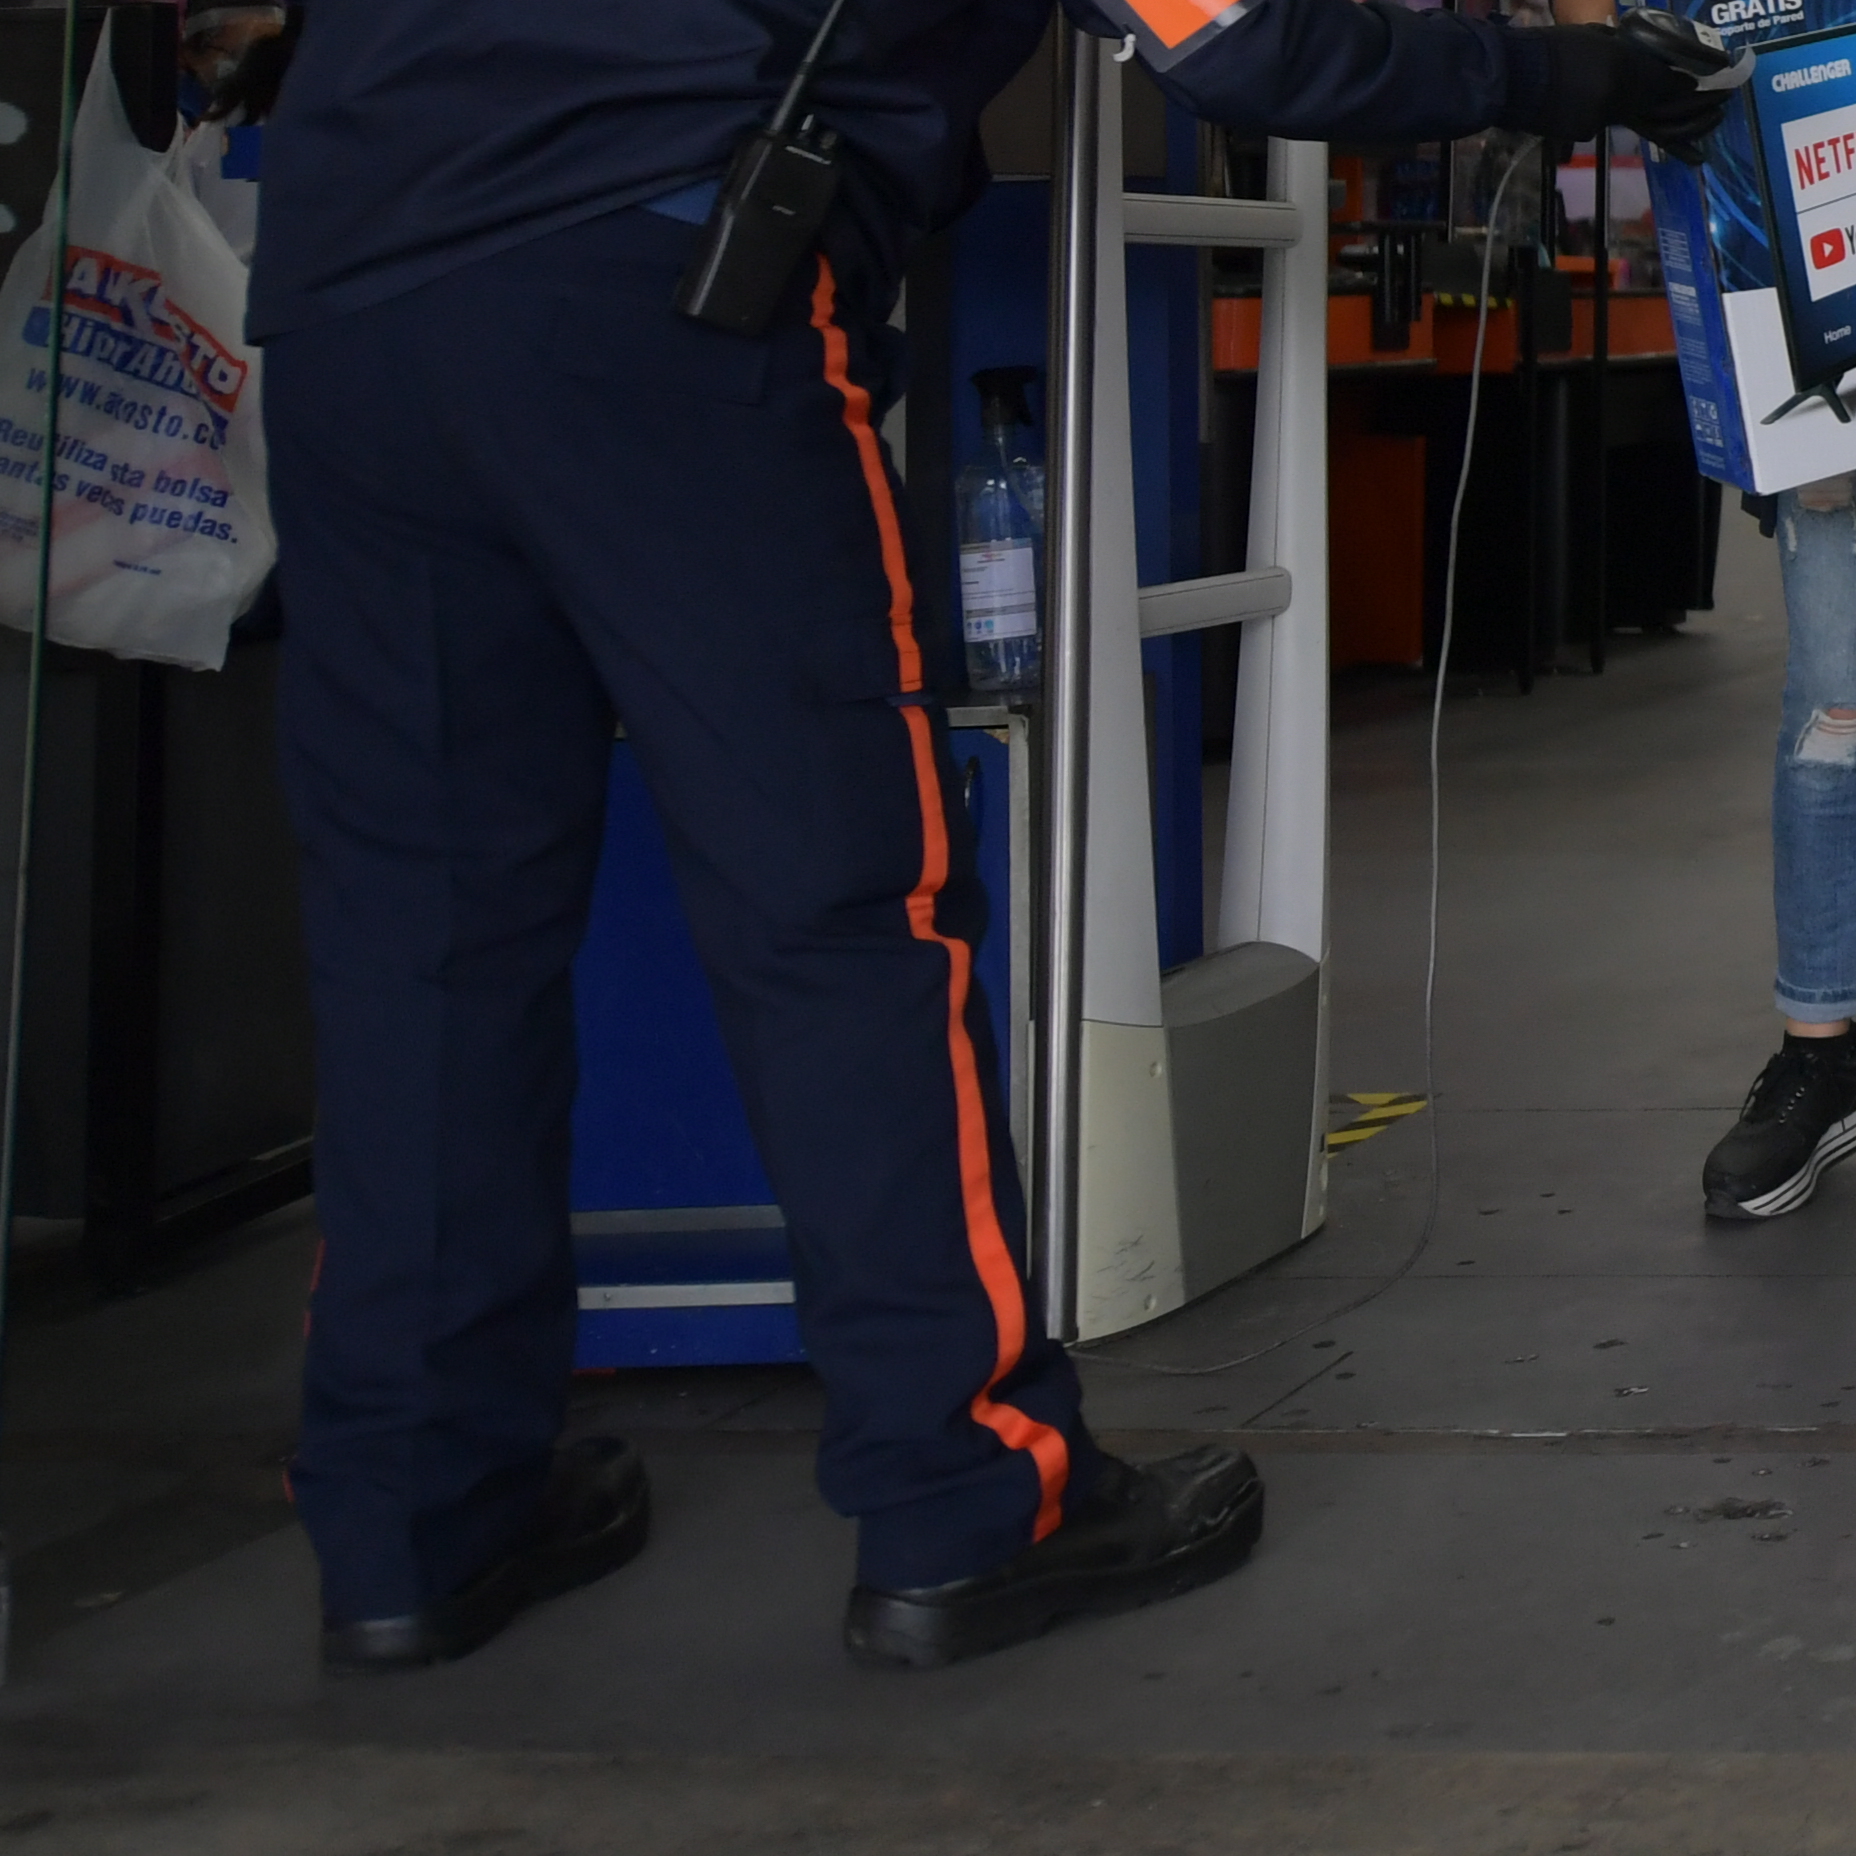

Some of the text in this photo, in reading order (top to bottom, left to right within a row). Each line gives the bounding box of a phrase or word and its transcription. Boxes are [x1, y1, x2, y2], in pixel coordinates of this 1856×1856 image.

[1757, 18, 1771, 28] de
[1773, 10, 1804, 24] Pared
[1771, 58, 1852, 93] CHALLENGER
[1823, 325, 1852, 344] Home
[154, 470, 229, 508] bolsa
[130, 503, 238, 544] puedas.
